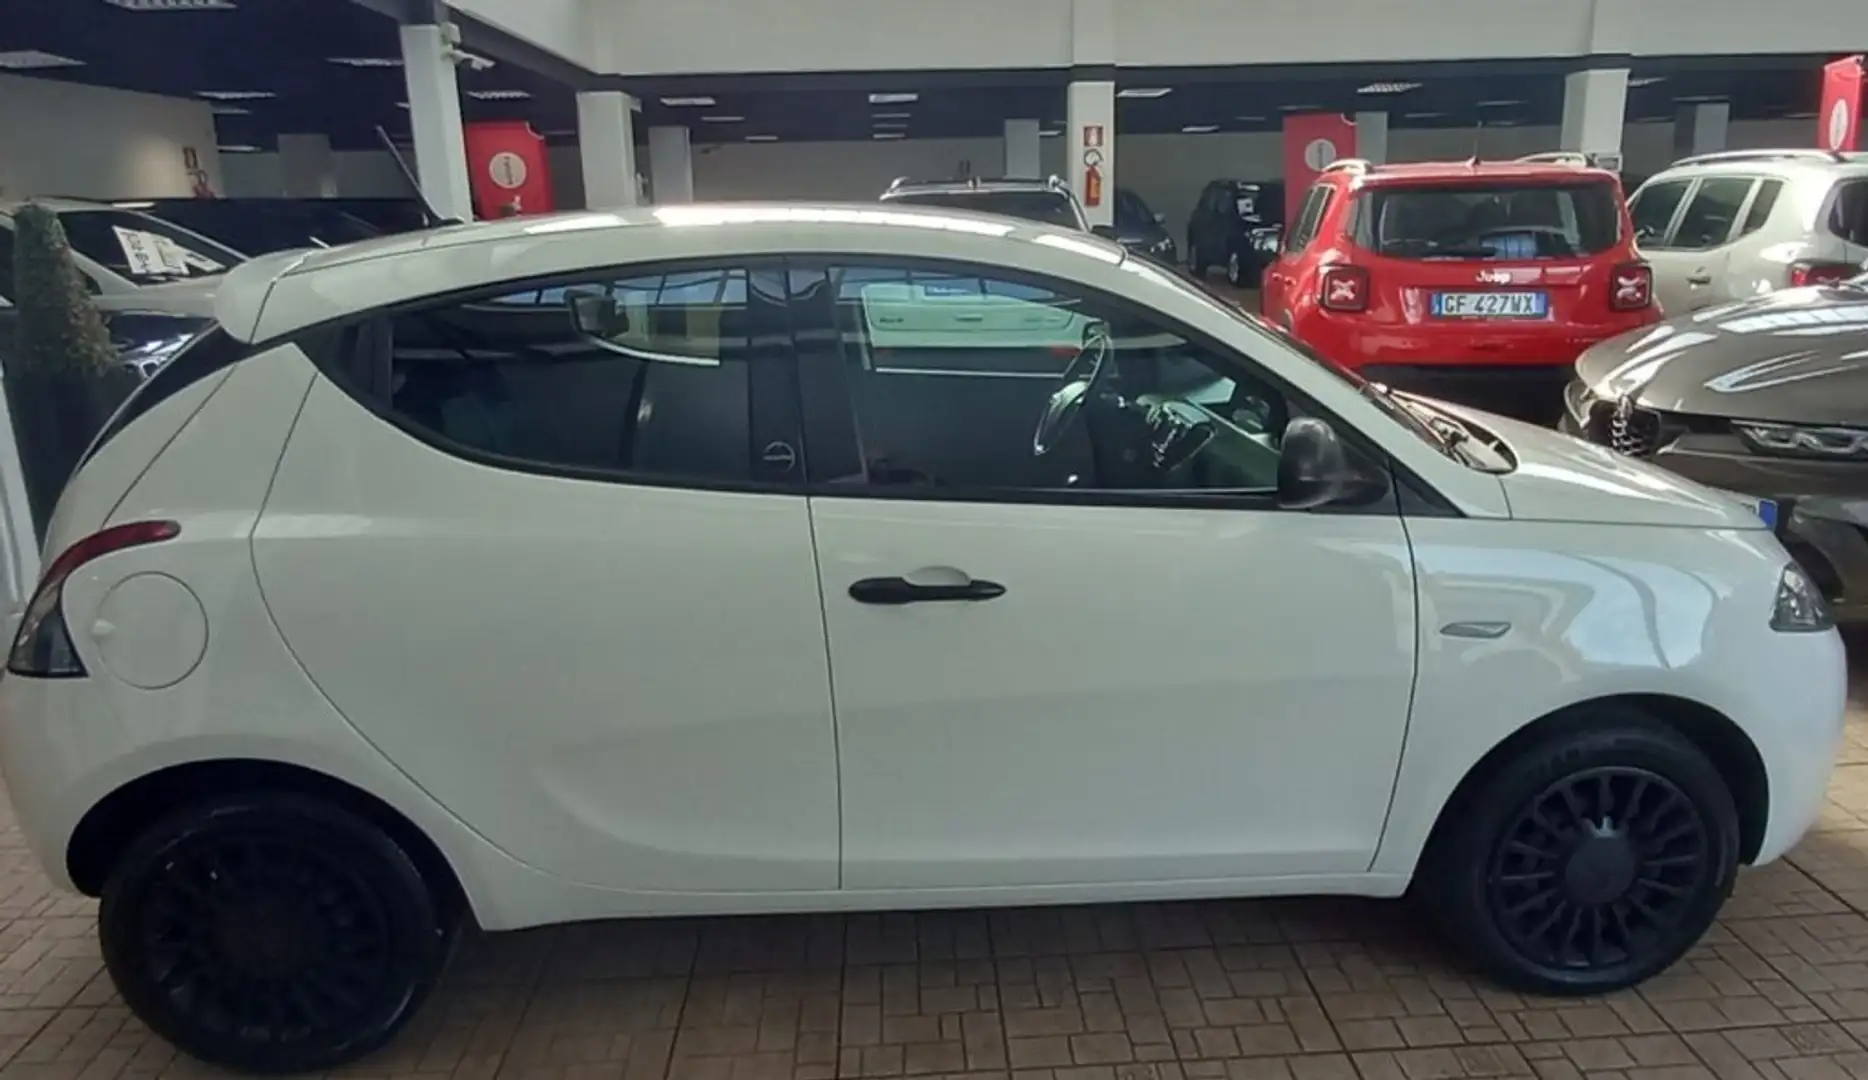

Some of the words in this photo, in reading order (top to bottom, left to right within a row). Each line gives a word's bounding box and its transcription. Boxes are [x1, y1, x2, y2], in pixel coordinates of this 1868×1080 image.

[1476, 269, 1511, 284] Jeep
[1445, 295, 1466, 312] GF
[1474, 295, 1533, 312] 427WX
